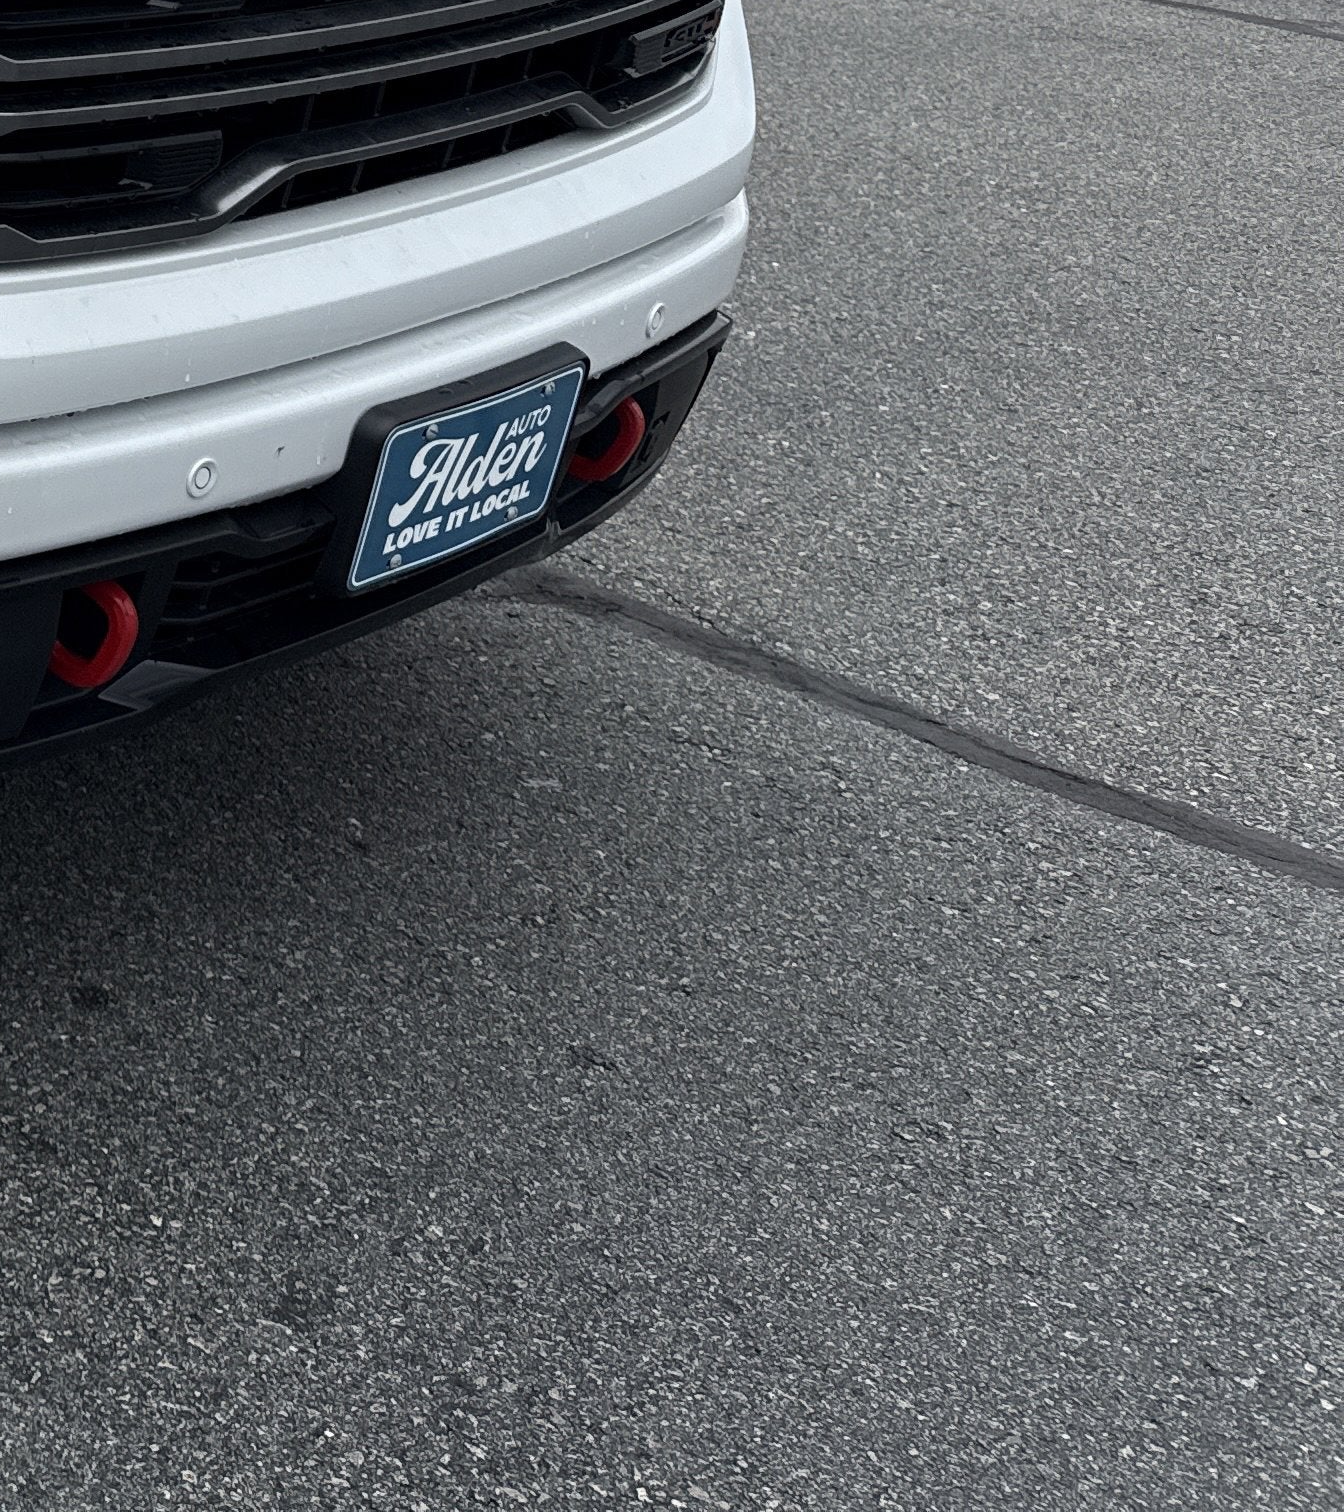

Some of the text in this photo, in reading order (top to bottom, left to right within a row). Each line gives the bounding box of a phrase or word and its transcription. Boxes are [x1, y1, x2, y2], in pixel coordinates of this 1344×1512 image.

[508, 404, 552, 439] AUTO
[388, 422, 548, 528] Alden
[382, 481, 531, 555] LOVE IT LOCAL
